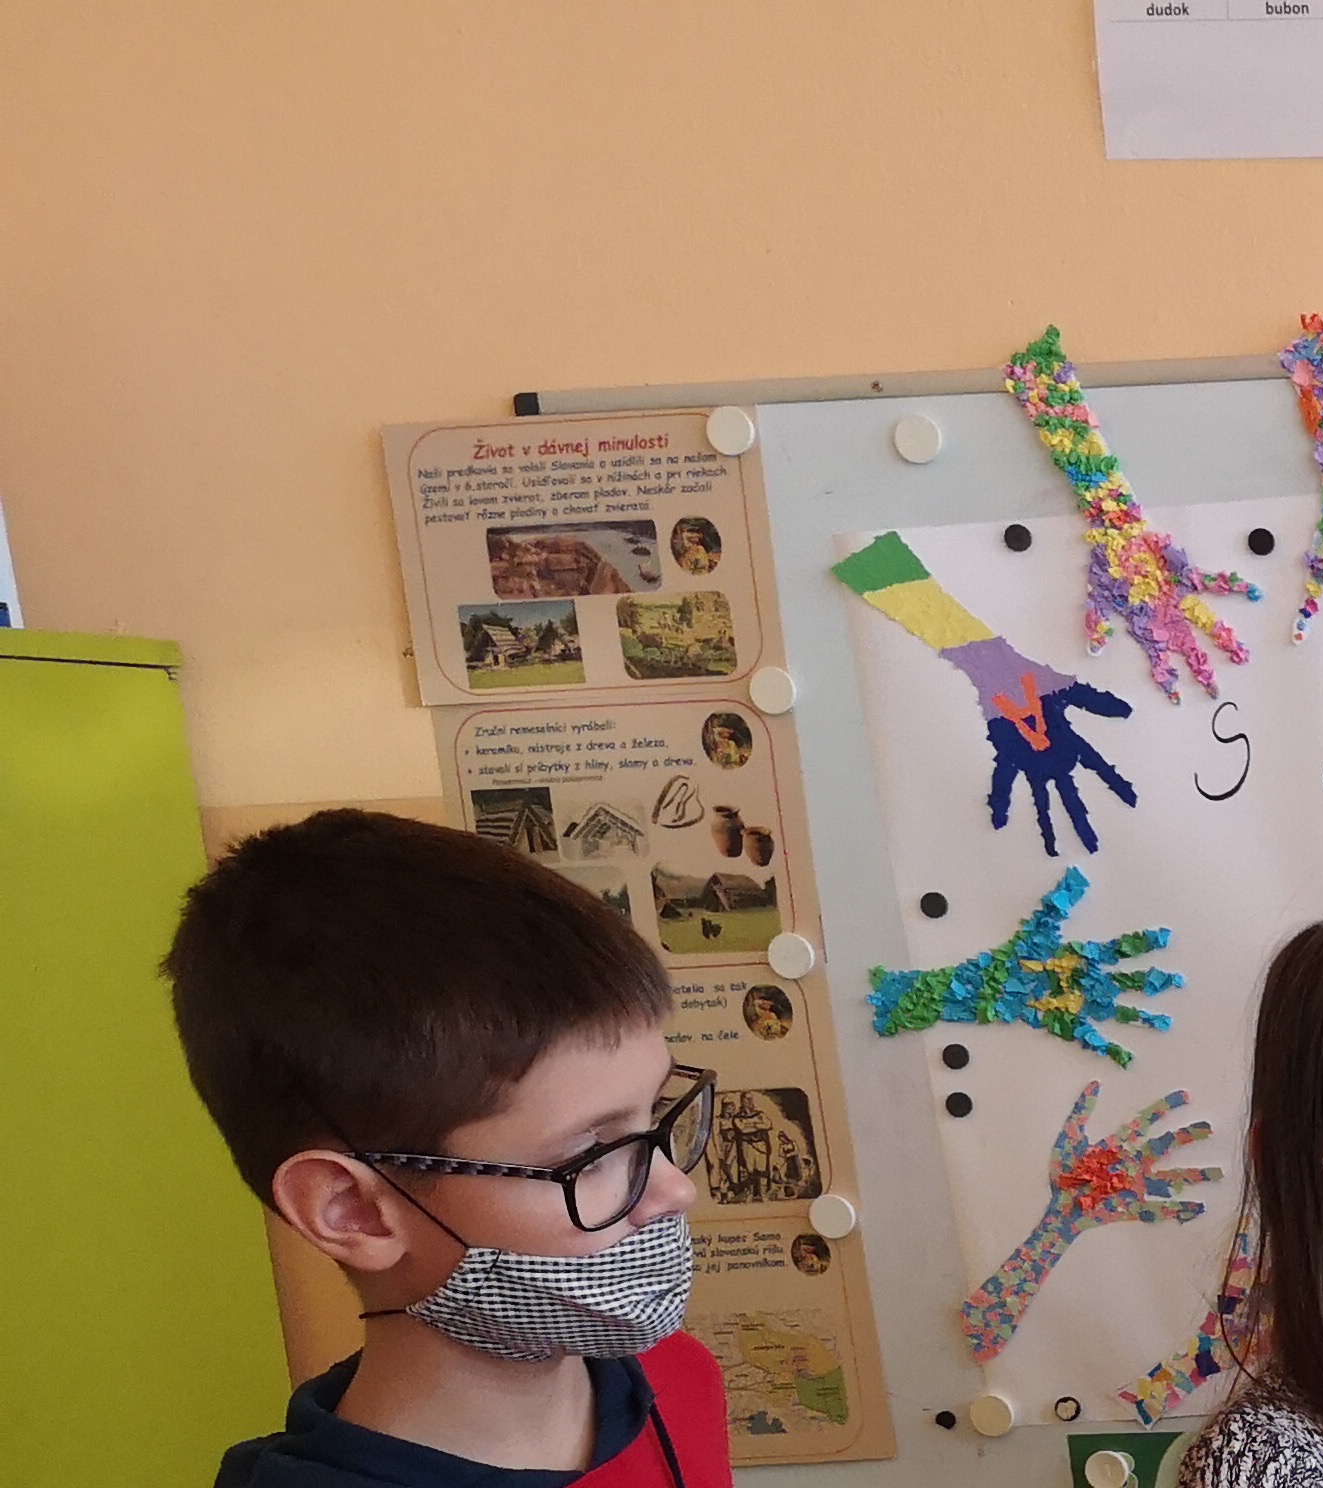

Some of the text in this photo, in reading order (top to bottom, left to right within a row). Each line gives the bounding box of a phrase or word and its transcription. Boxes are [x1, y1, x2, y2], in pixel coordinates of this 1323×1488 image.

[1145, 1, 1310, 17] dudok bubon
[472, 433, 669, 460] Život v dávnej minulosti
[1194, 701, 1252, 802] S
[717, 1231, 782, 1244] kupec Samo
[705, 1260, 721, 1274] jej
